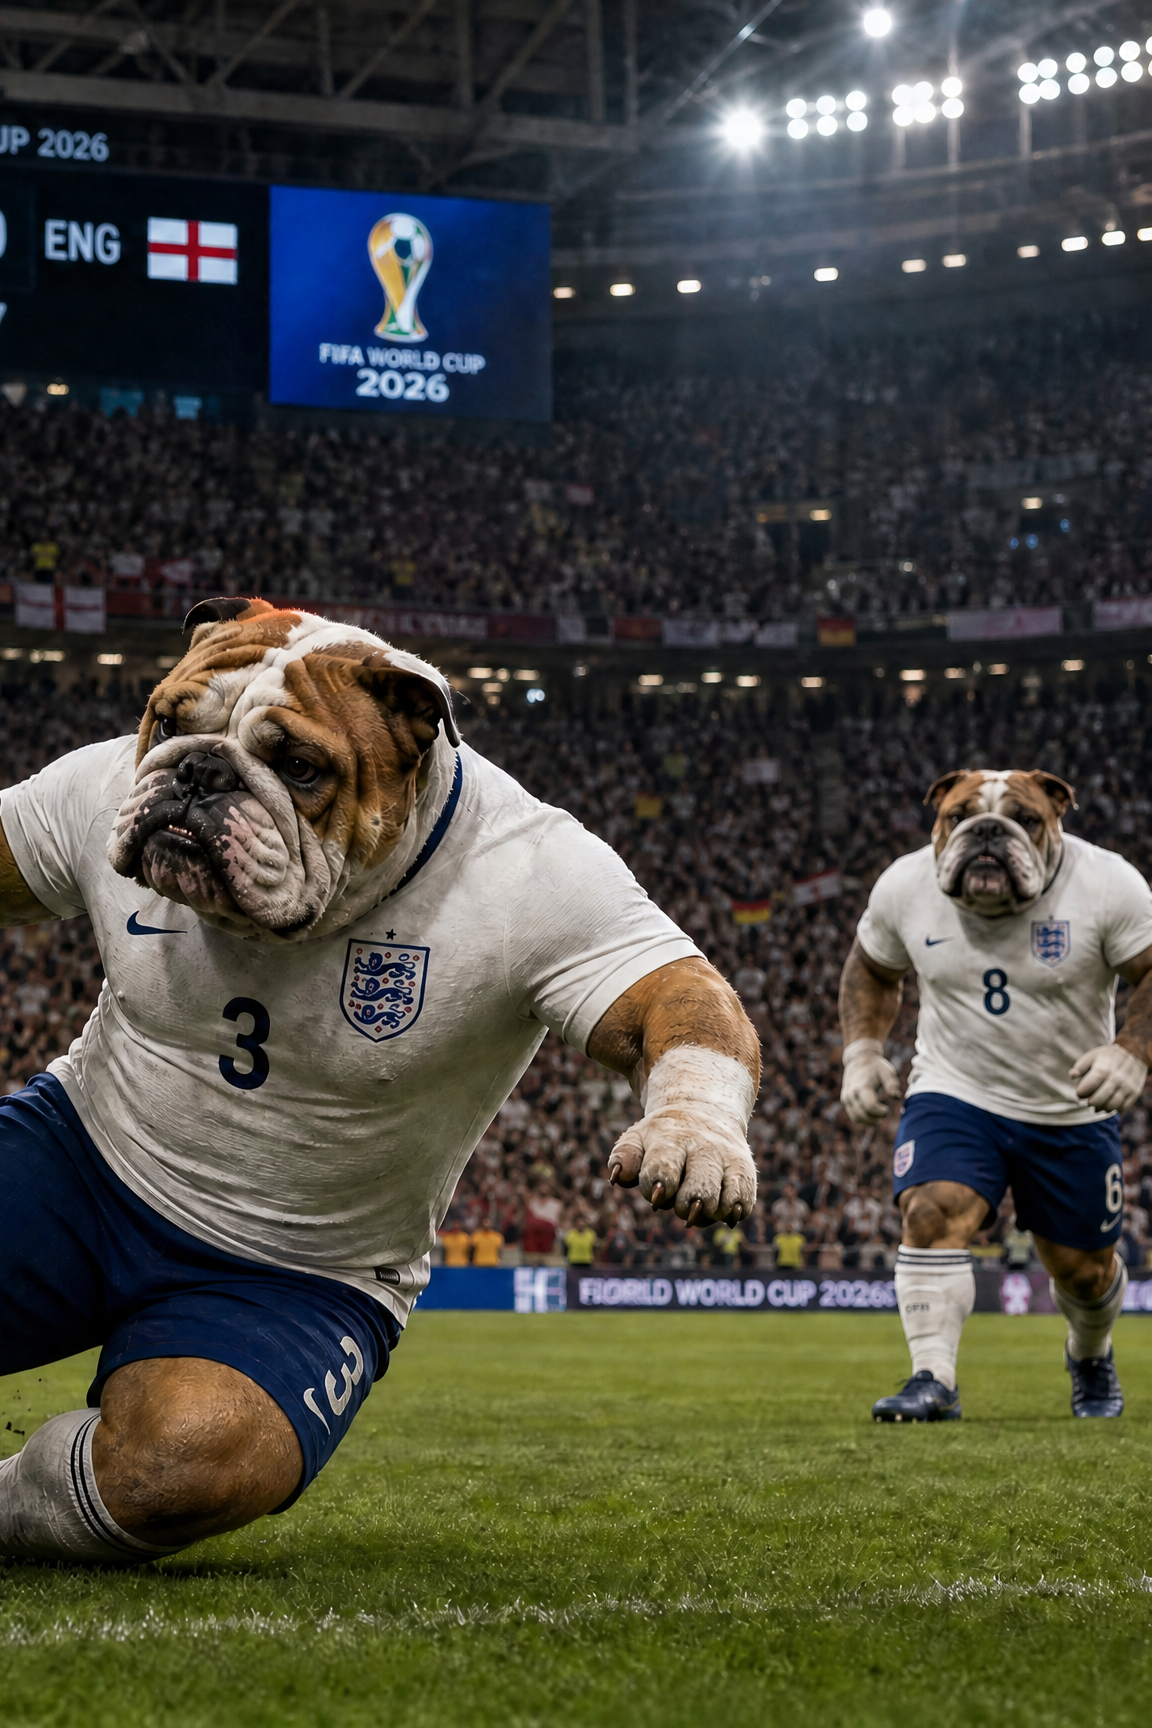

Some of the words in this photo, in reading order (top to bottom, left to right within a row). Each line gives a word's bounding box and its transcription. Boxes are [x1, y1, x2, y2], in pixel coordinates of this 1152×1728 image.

[37, 128, 110, 163] 2026
[44, 217, 121, 266] ENG
[319, 342, 366, 367] FIFA
[366, 346, 441, 371] WORLD
[442, 351, 486, 375] CUP
[355, 366, 450, 403] 2026
[983, 968, 1011, 1016] 8
[218, 996, 270, 1090] 3
[1105, 1163, 1123, 1214] 6
[674, 1278, 766, 1308] WORLD
[767, 1279, 818, 1308] CUP
[324, 1335, 364, 1416] 3
